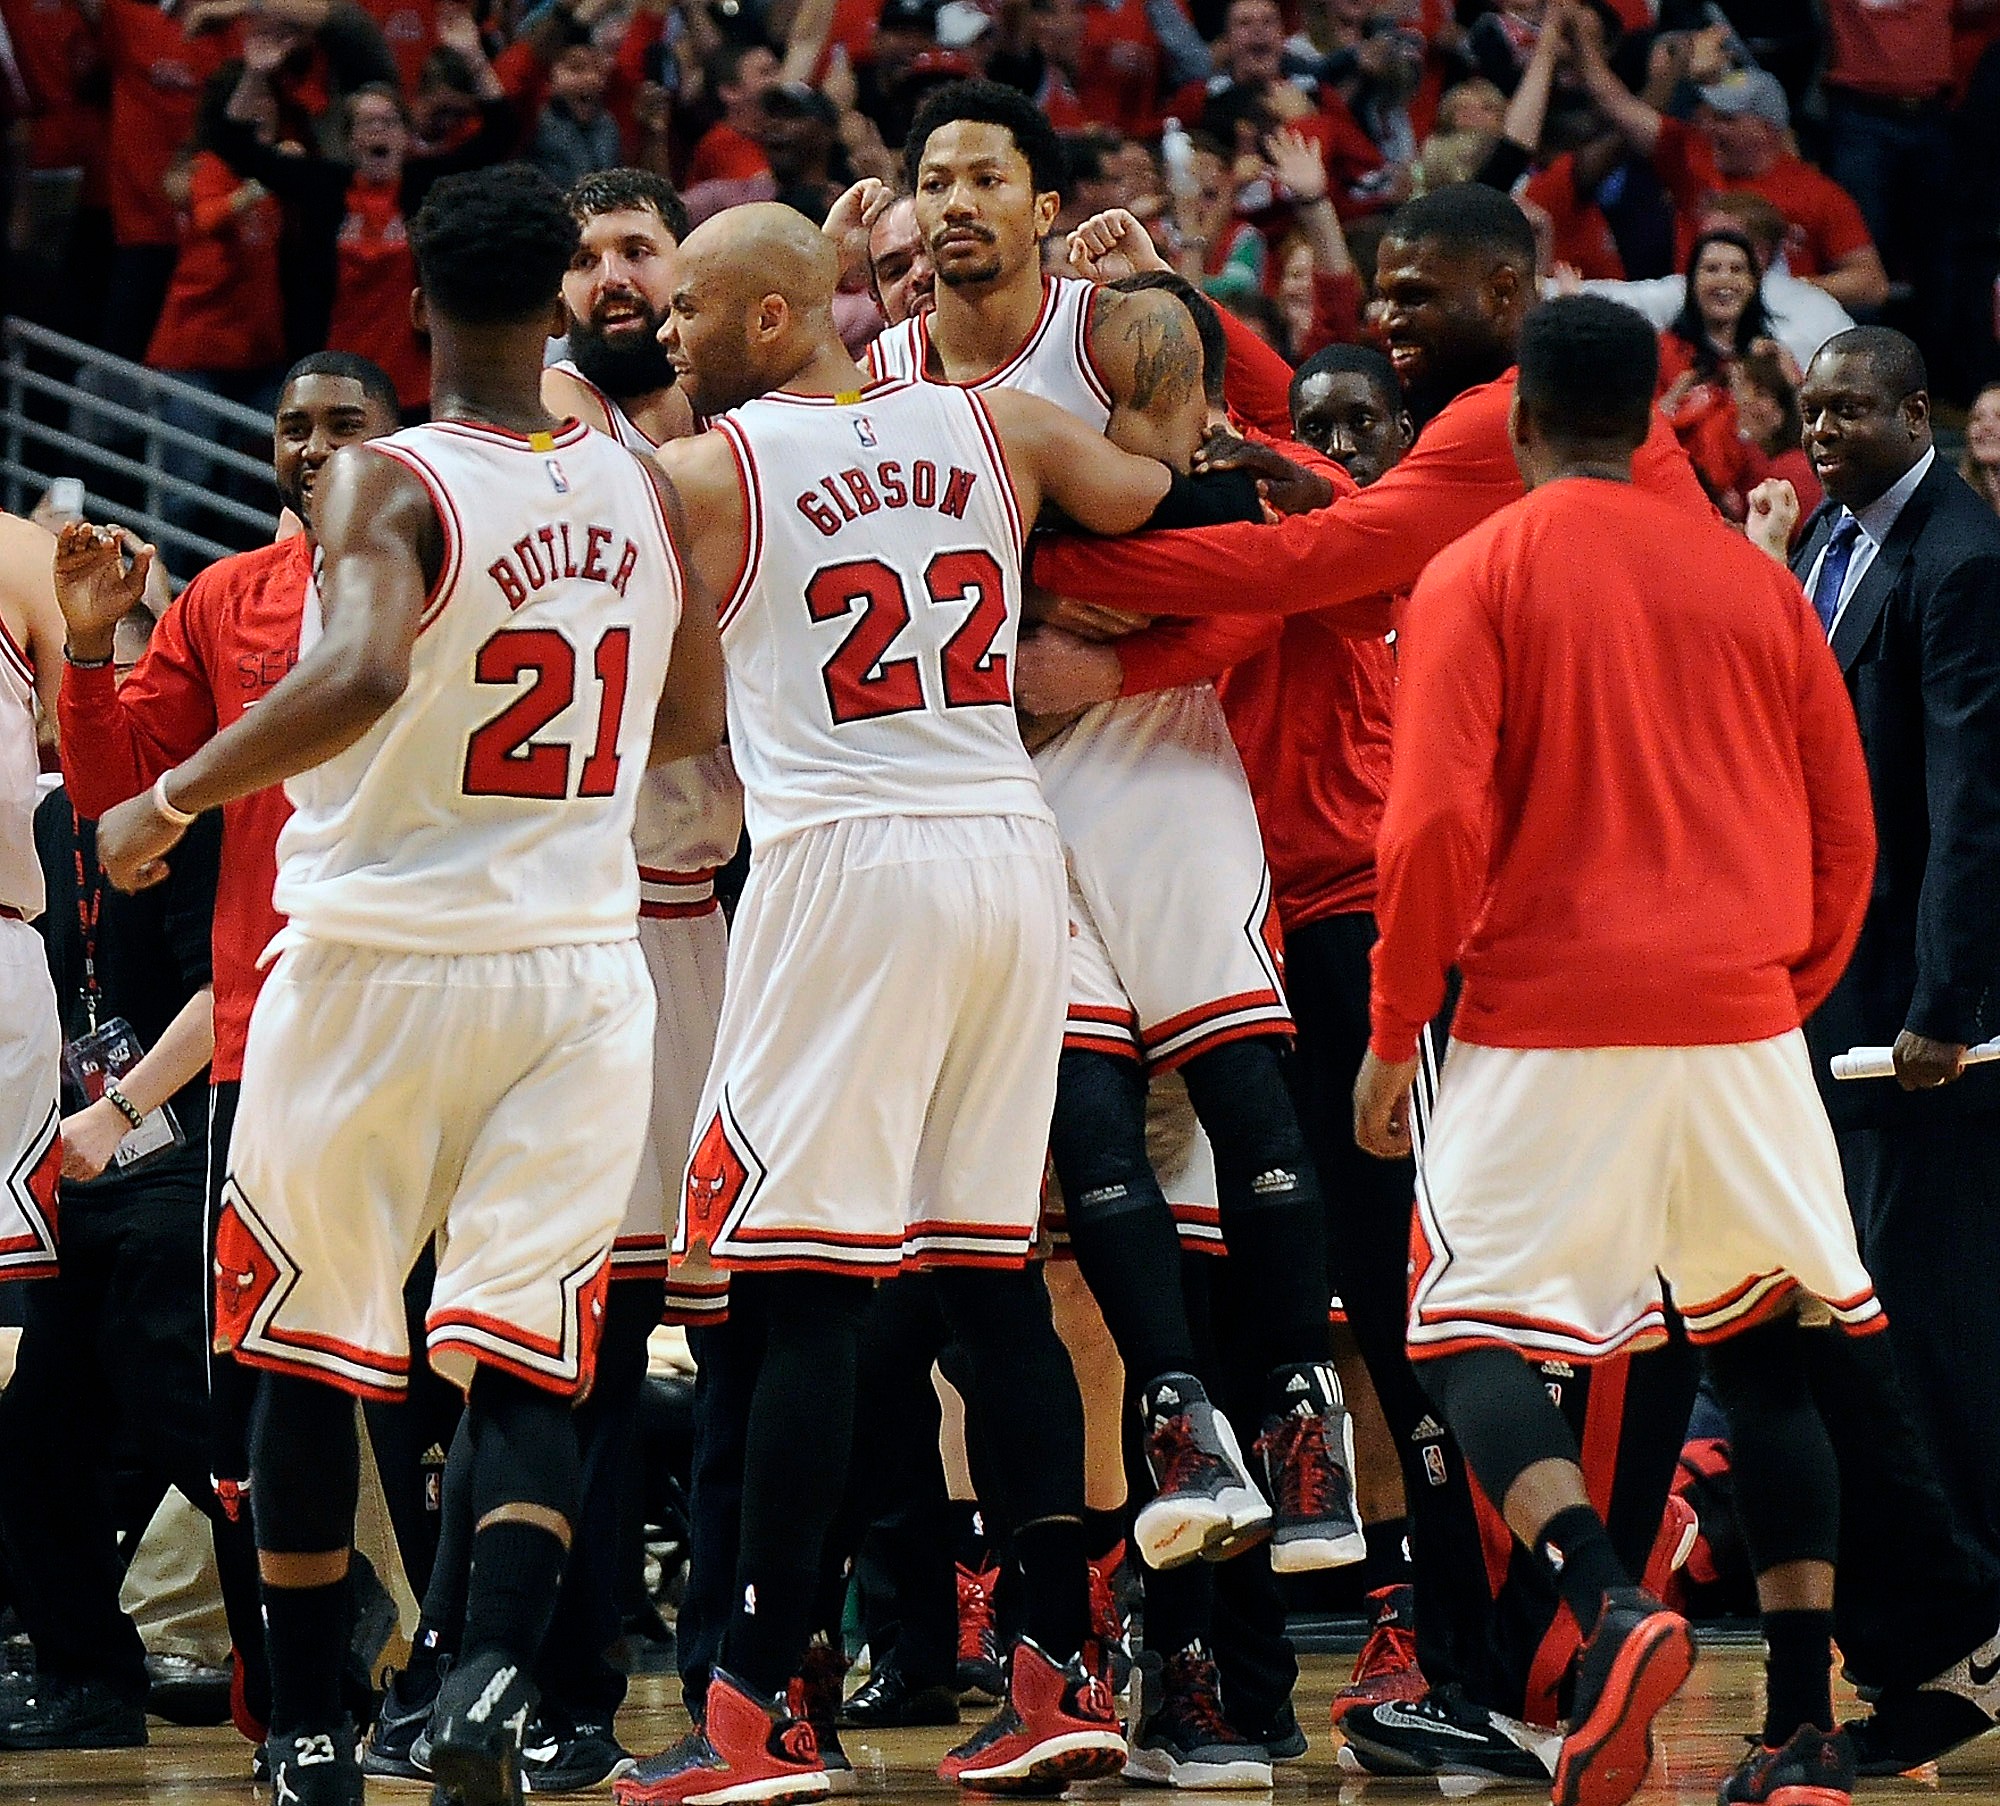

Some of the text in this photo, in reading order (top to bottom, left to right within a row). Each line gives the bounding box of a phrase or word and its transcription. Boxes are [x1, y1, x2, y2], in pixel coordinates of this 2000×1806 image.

[796, 459, 977, 537] GIBSON
[488, 522, 640, 611] BUTLER
[804, 549, 1012, 725] 22
[463, 627, 630, 800] 21
[294, 1734, 335, 1767] 23
